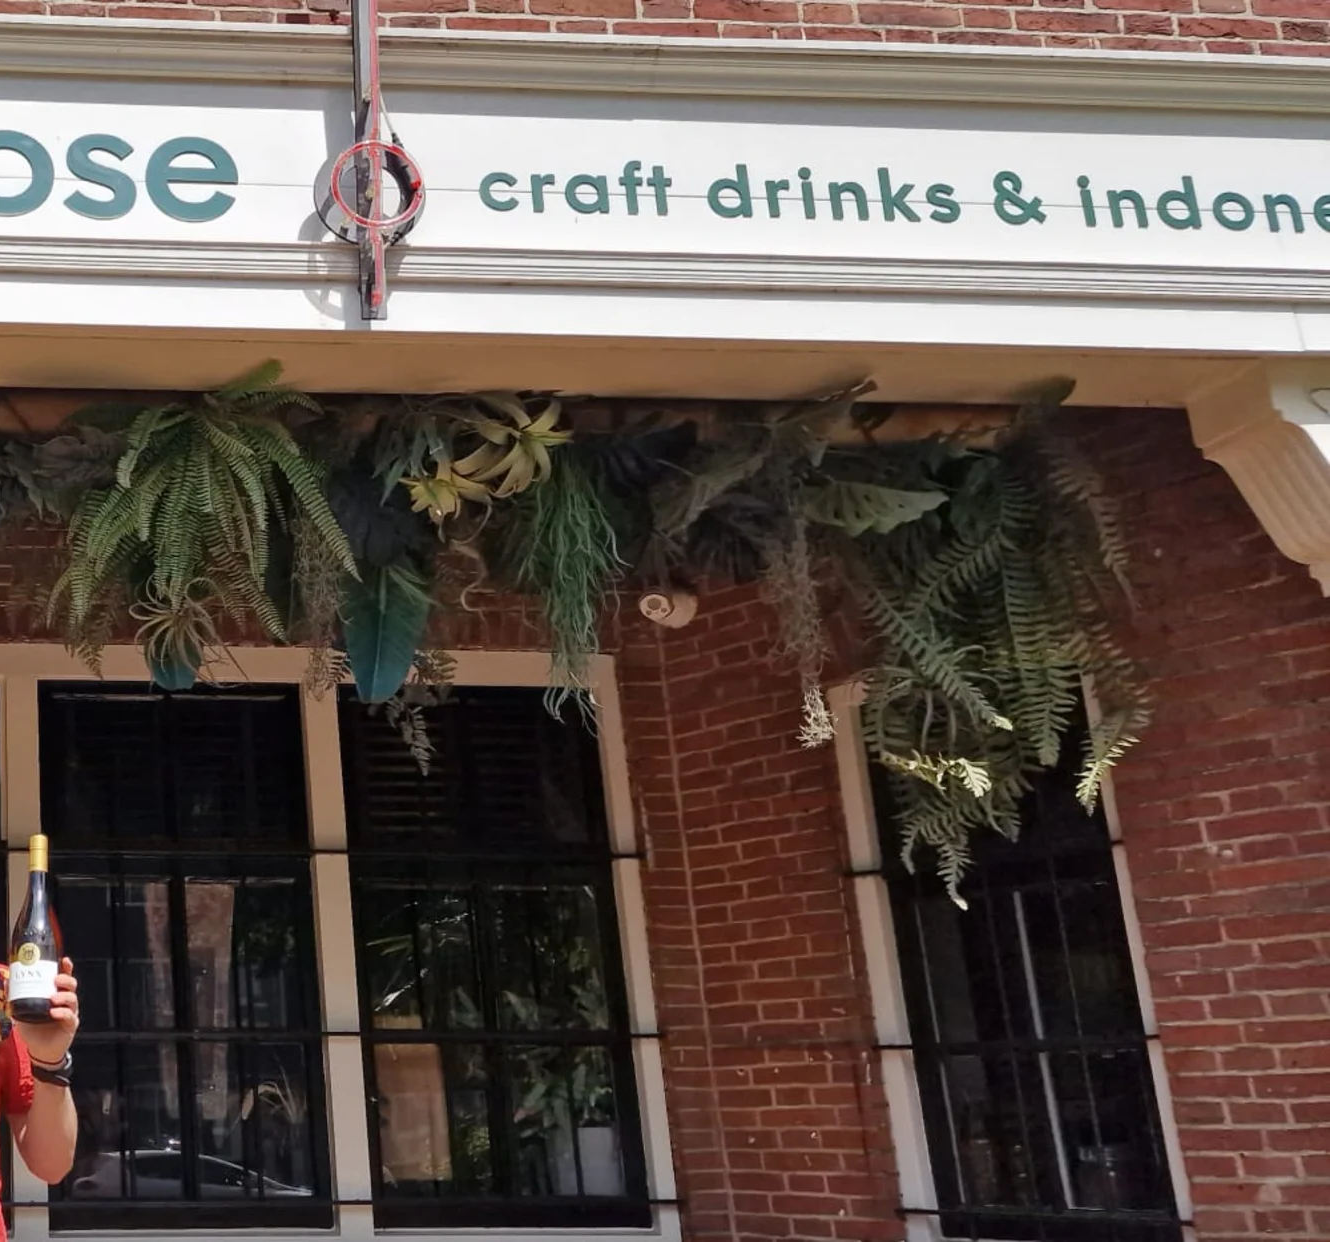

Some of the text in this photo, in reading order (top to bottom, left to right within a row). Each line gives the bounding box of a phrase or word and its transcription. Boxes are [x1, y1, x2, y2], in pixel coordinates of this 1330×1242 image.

[479, 160, 672, 216] craft
[707, 164, 961, 224] drinks
[993, 170, 1047, 225] &
